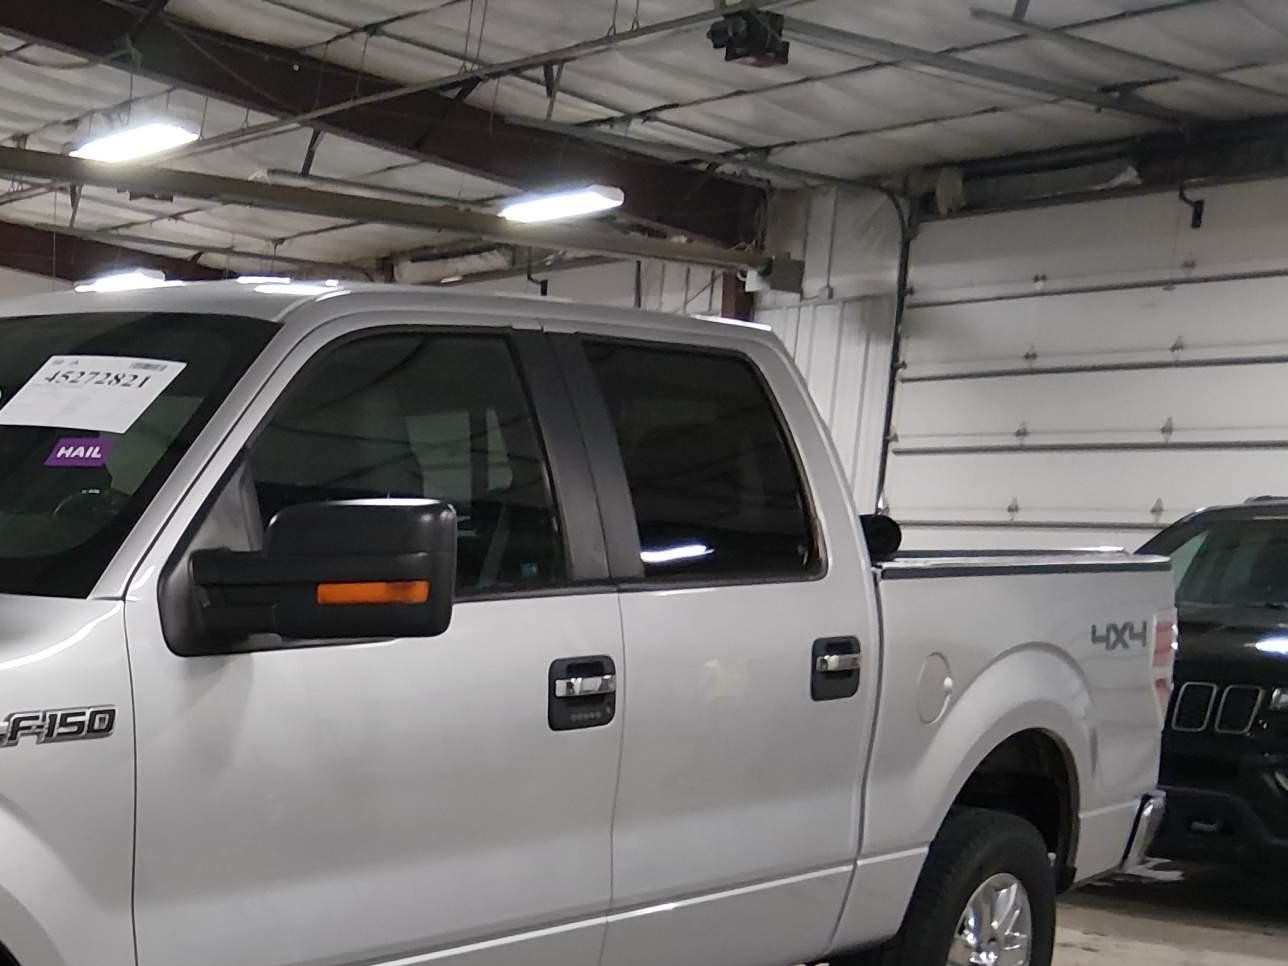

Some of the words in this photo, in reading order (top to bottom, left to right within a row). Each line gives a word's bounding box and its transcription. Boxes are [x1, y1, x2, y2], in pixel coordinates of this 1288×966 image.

[44, 370, 151, 388] 45272821
[56, 446, 102, 459] HAIL
[6, 706, 117, 744] F-150
